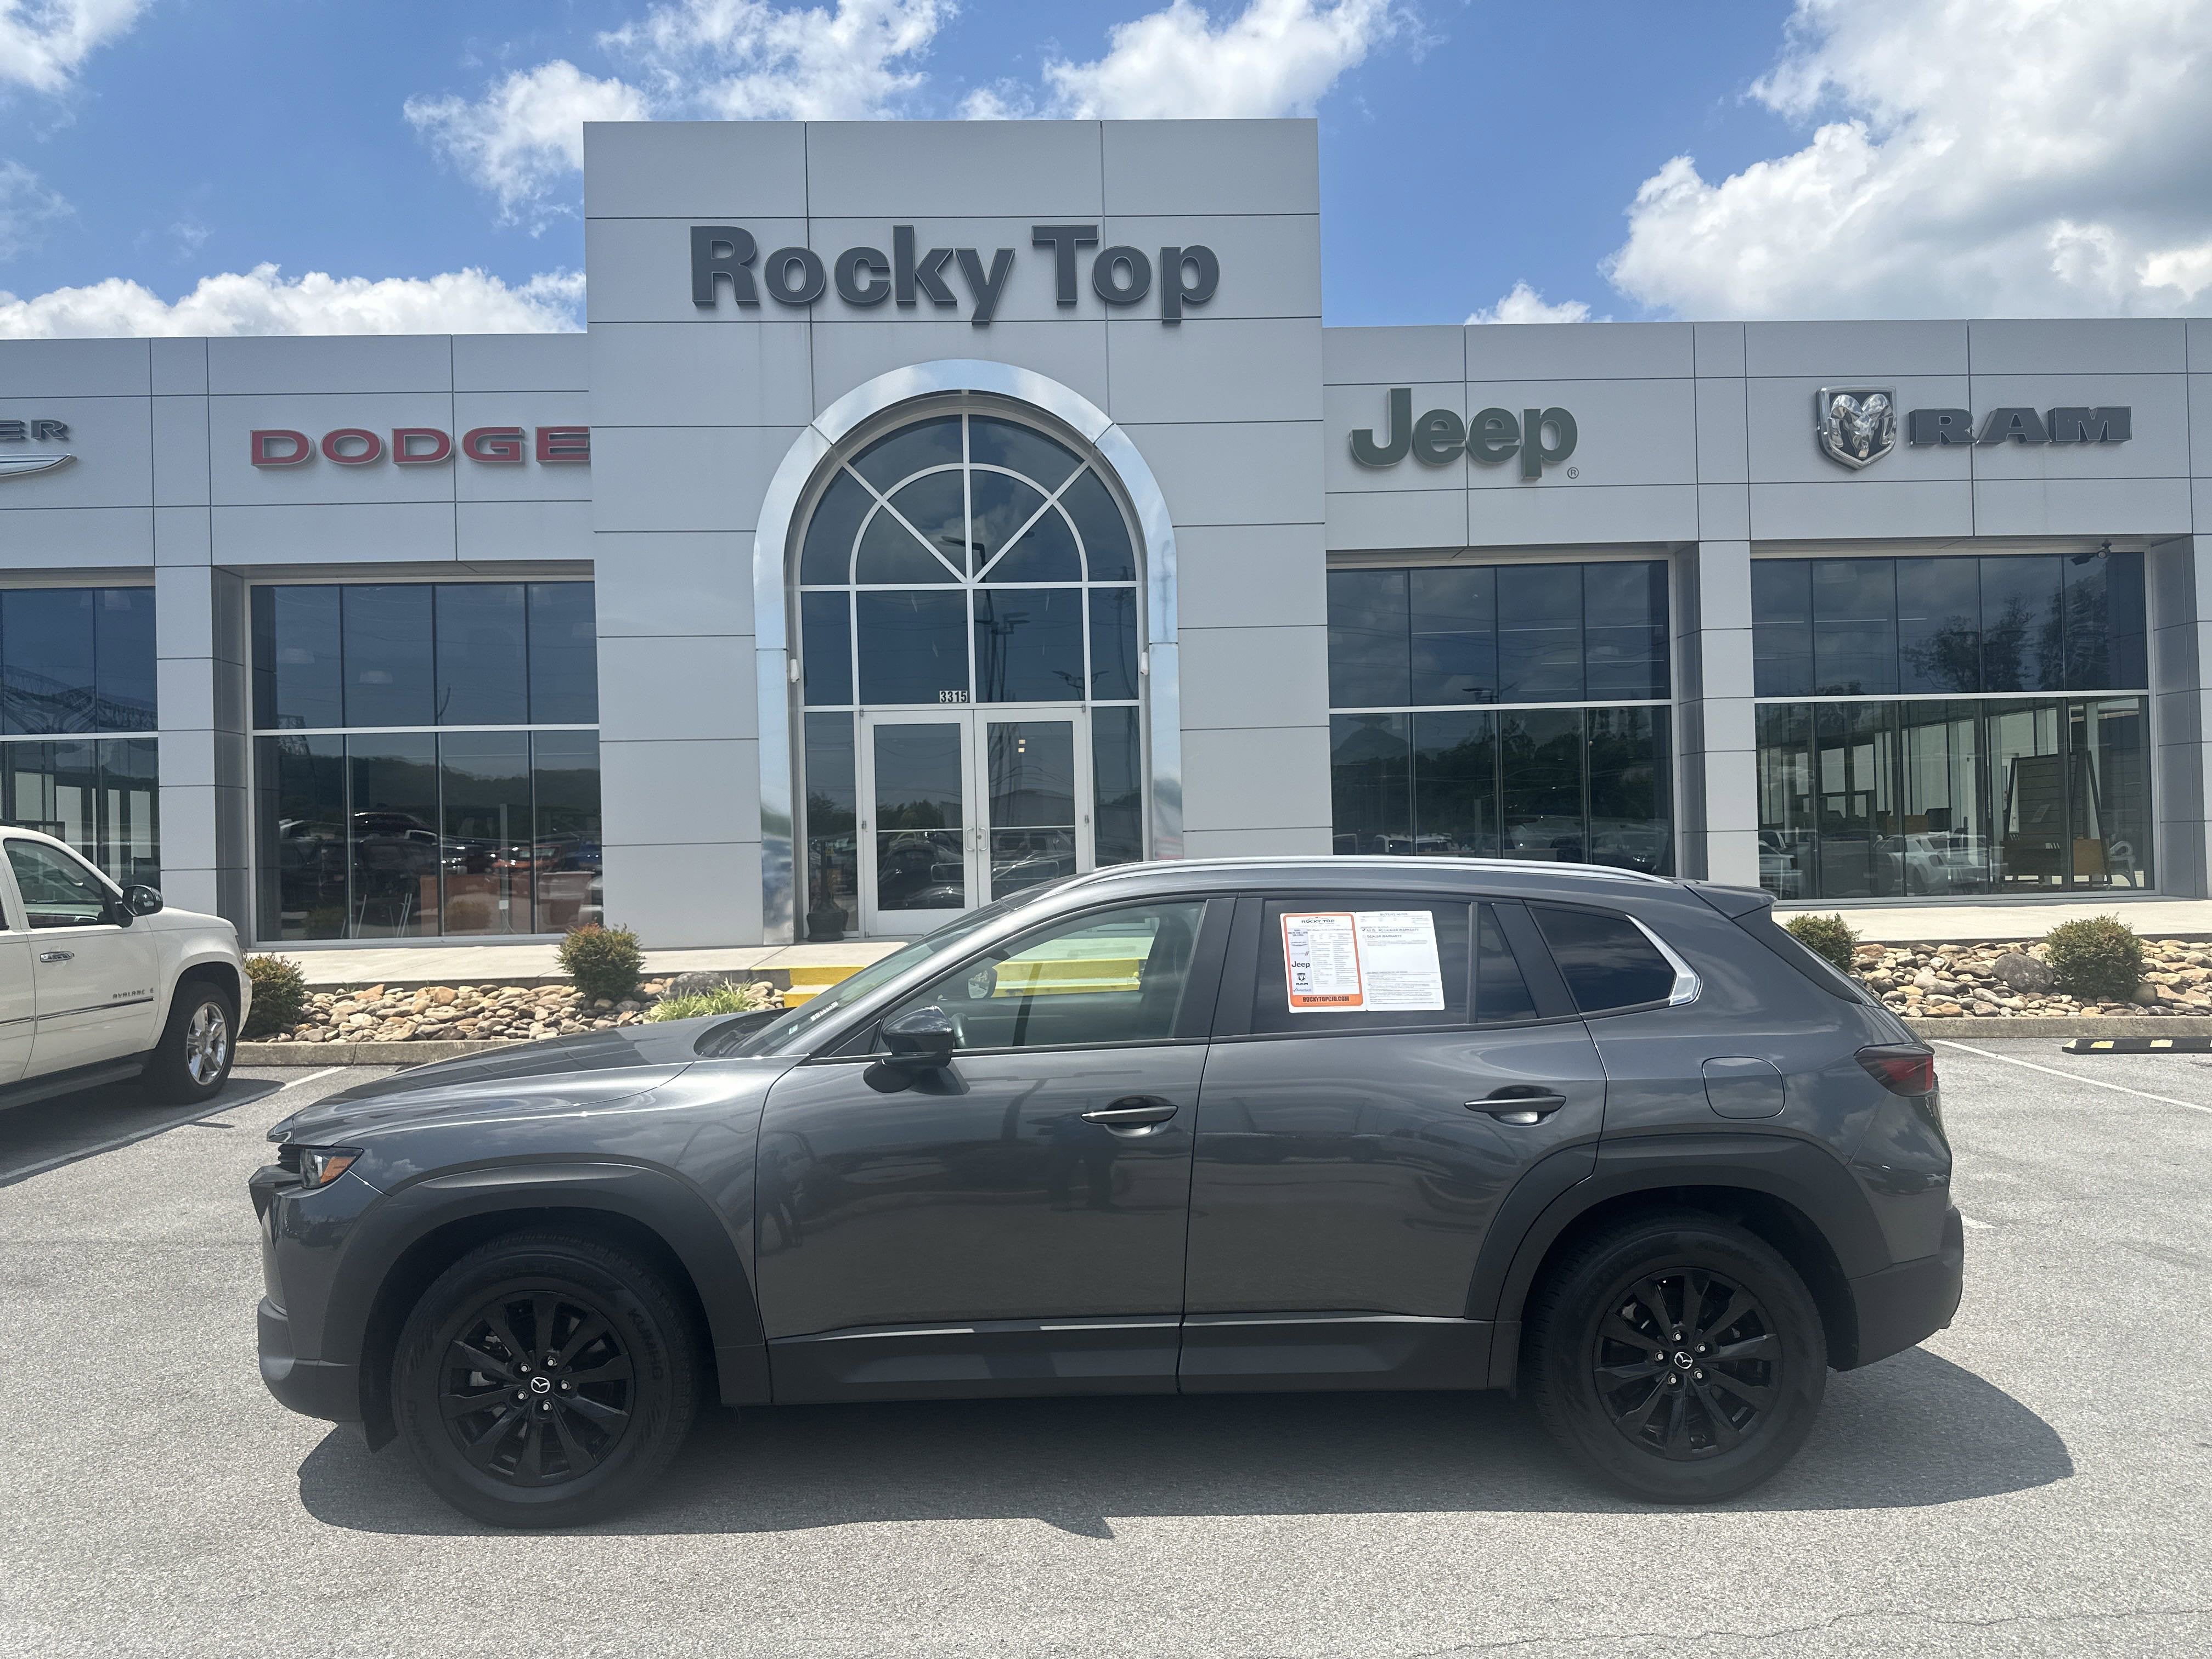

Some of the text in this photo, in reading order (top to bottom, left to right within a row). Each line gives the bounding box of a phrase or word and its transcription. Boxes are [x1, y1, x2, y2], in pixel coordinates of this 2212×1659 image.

[690, 224, 1219, 325] Rocky Top
[1349, 387, 1577, 481] Jeep
[1909, 406, 2132, 444] RAM
[250, 426, 591, 466] DODGE
[940, 691, 967, 702] 3315
[112, 988, 154, 999] AVALANCE
